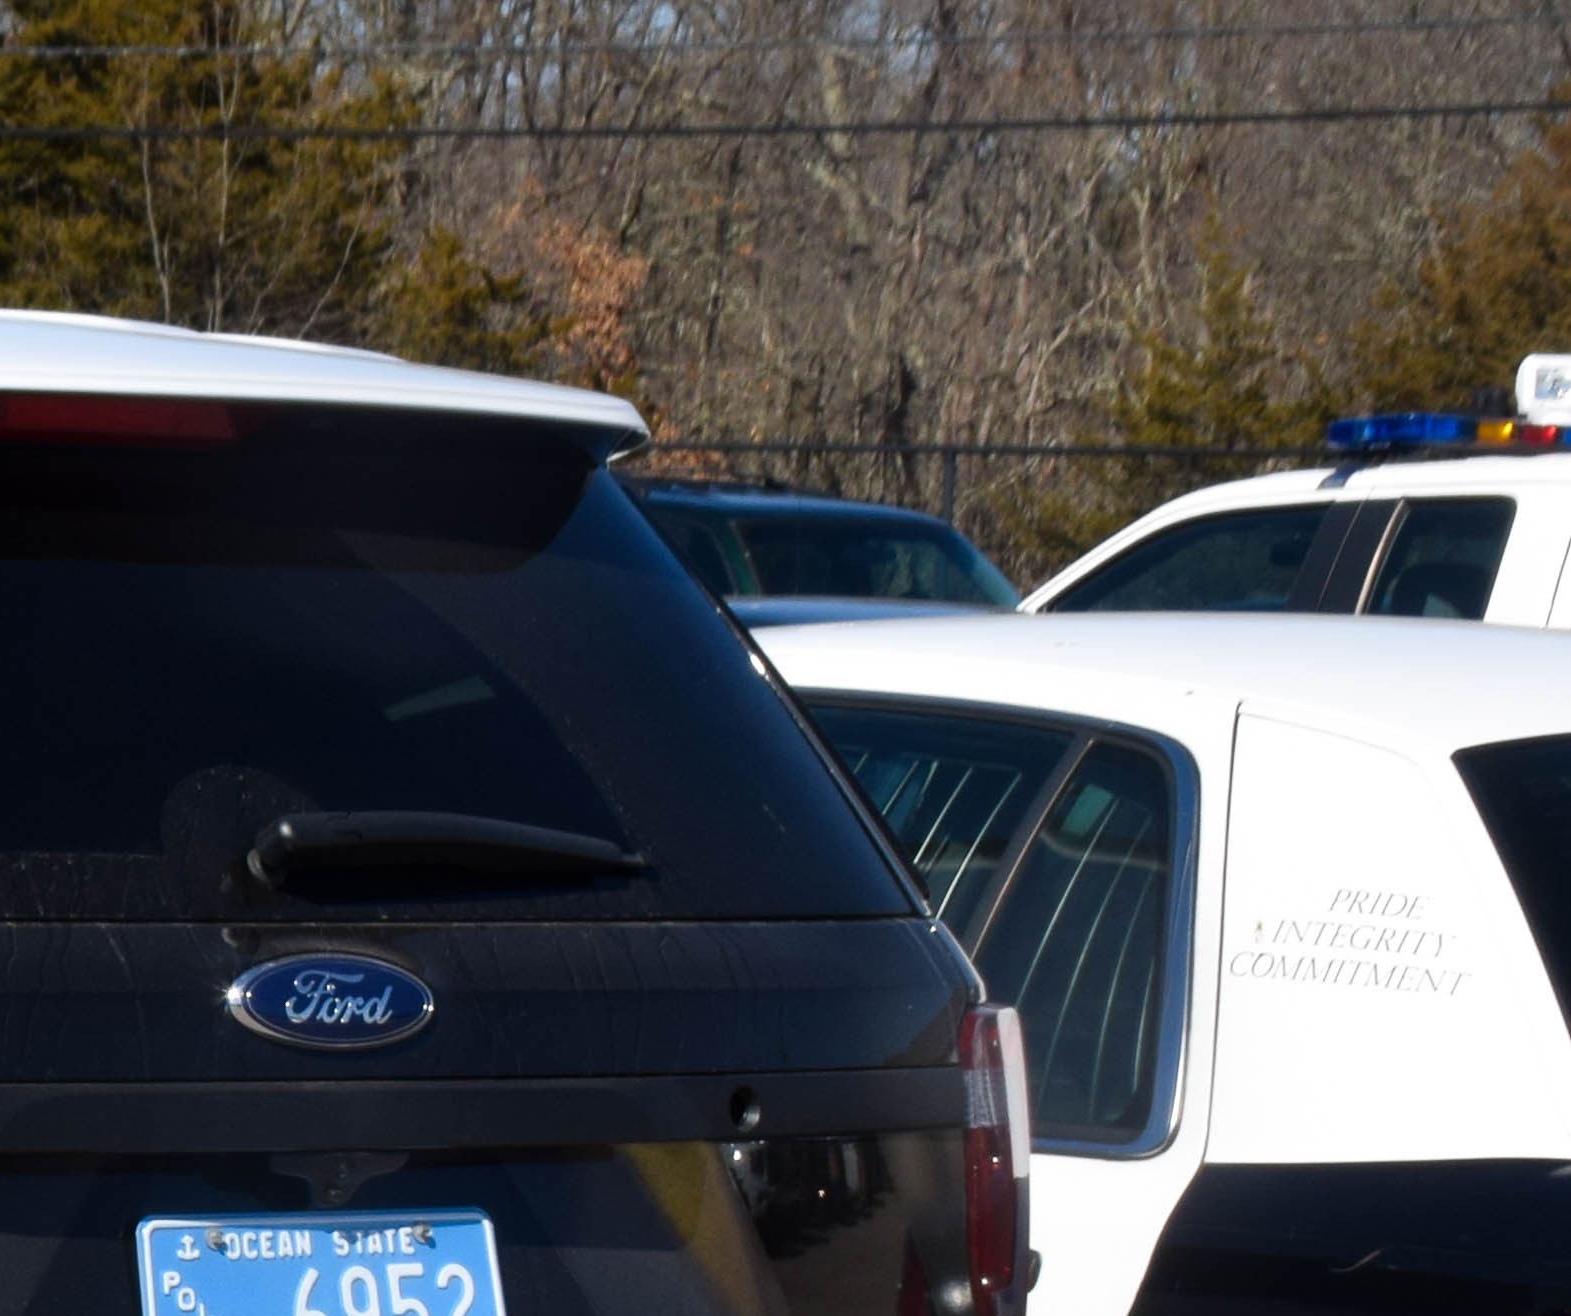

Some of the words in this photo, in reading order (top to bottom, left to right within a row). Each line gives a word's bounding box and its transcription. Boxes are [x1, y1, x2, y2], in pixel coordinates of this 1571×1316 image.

[1327, 888, 1430, 919] PRIDE
[1271, 919, 1457, 957] INTEGRITY
[1229, 951, 1473, 996] COMMITMENT
[285, 969, 393, 1024] Ford
[225, 1230, 313, 1260] OCEAN
[332, 1226, 416, 1257] STATE
